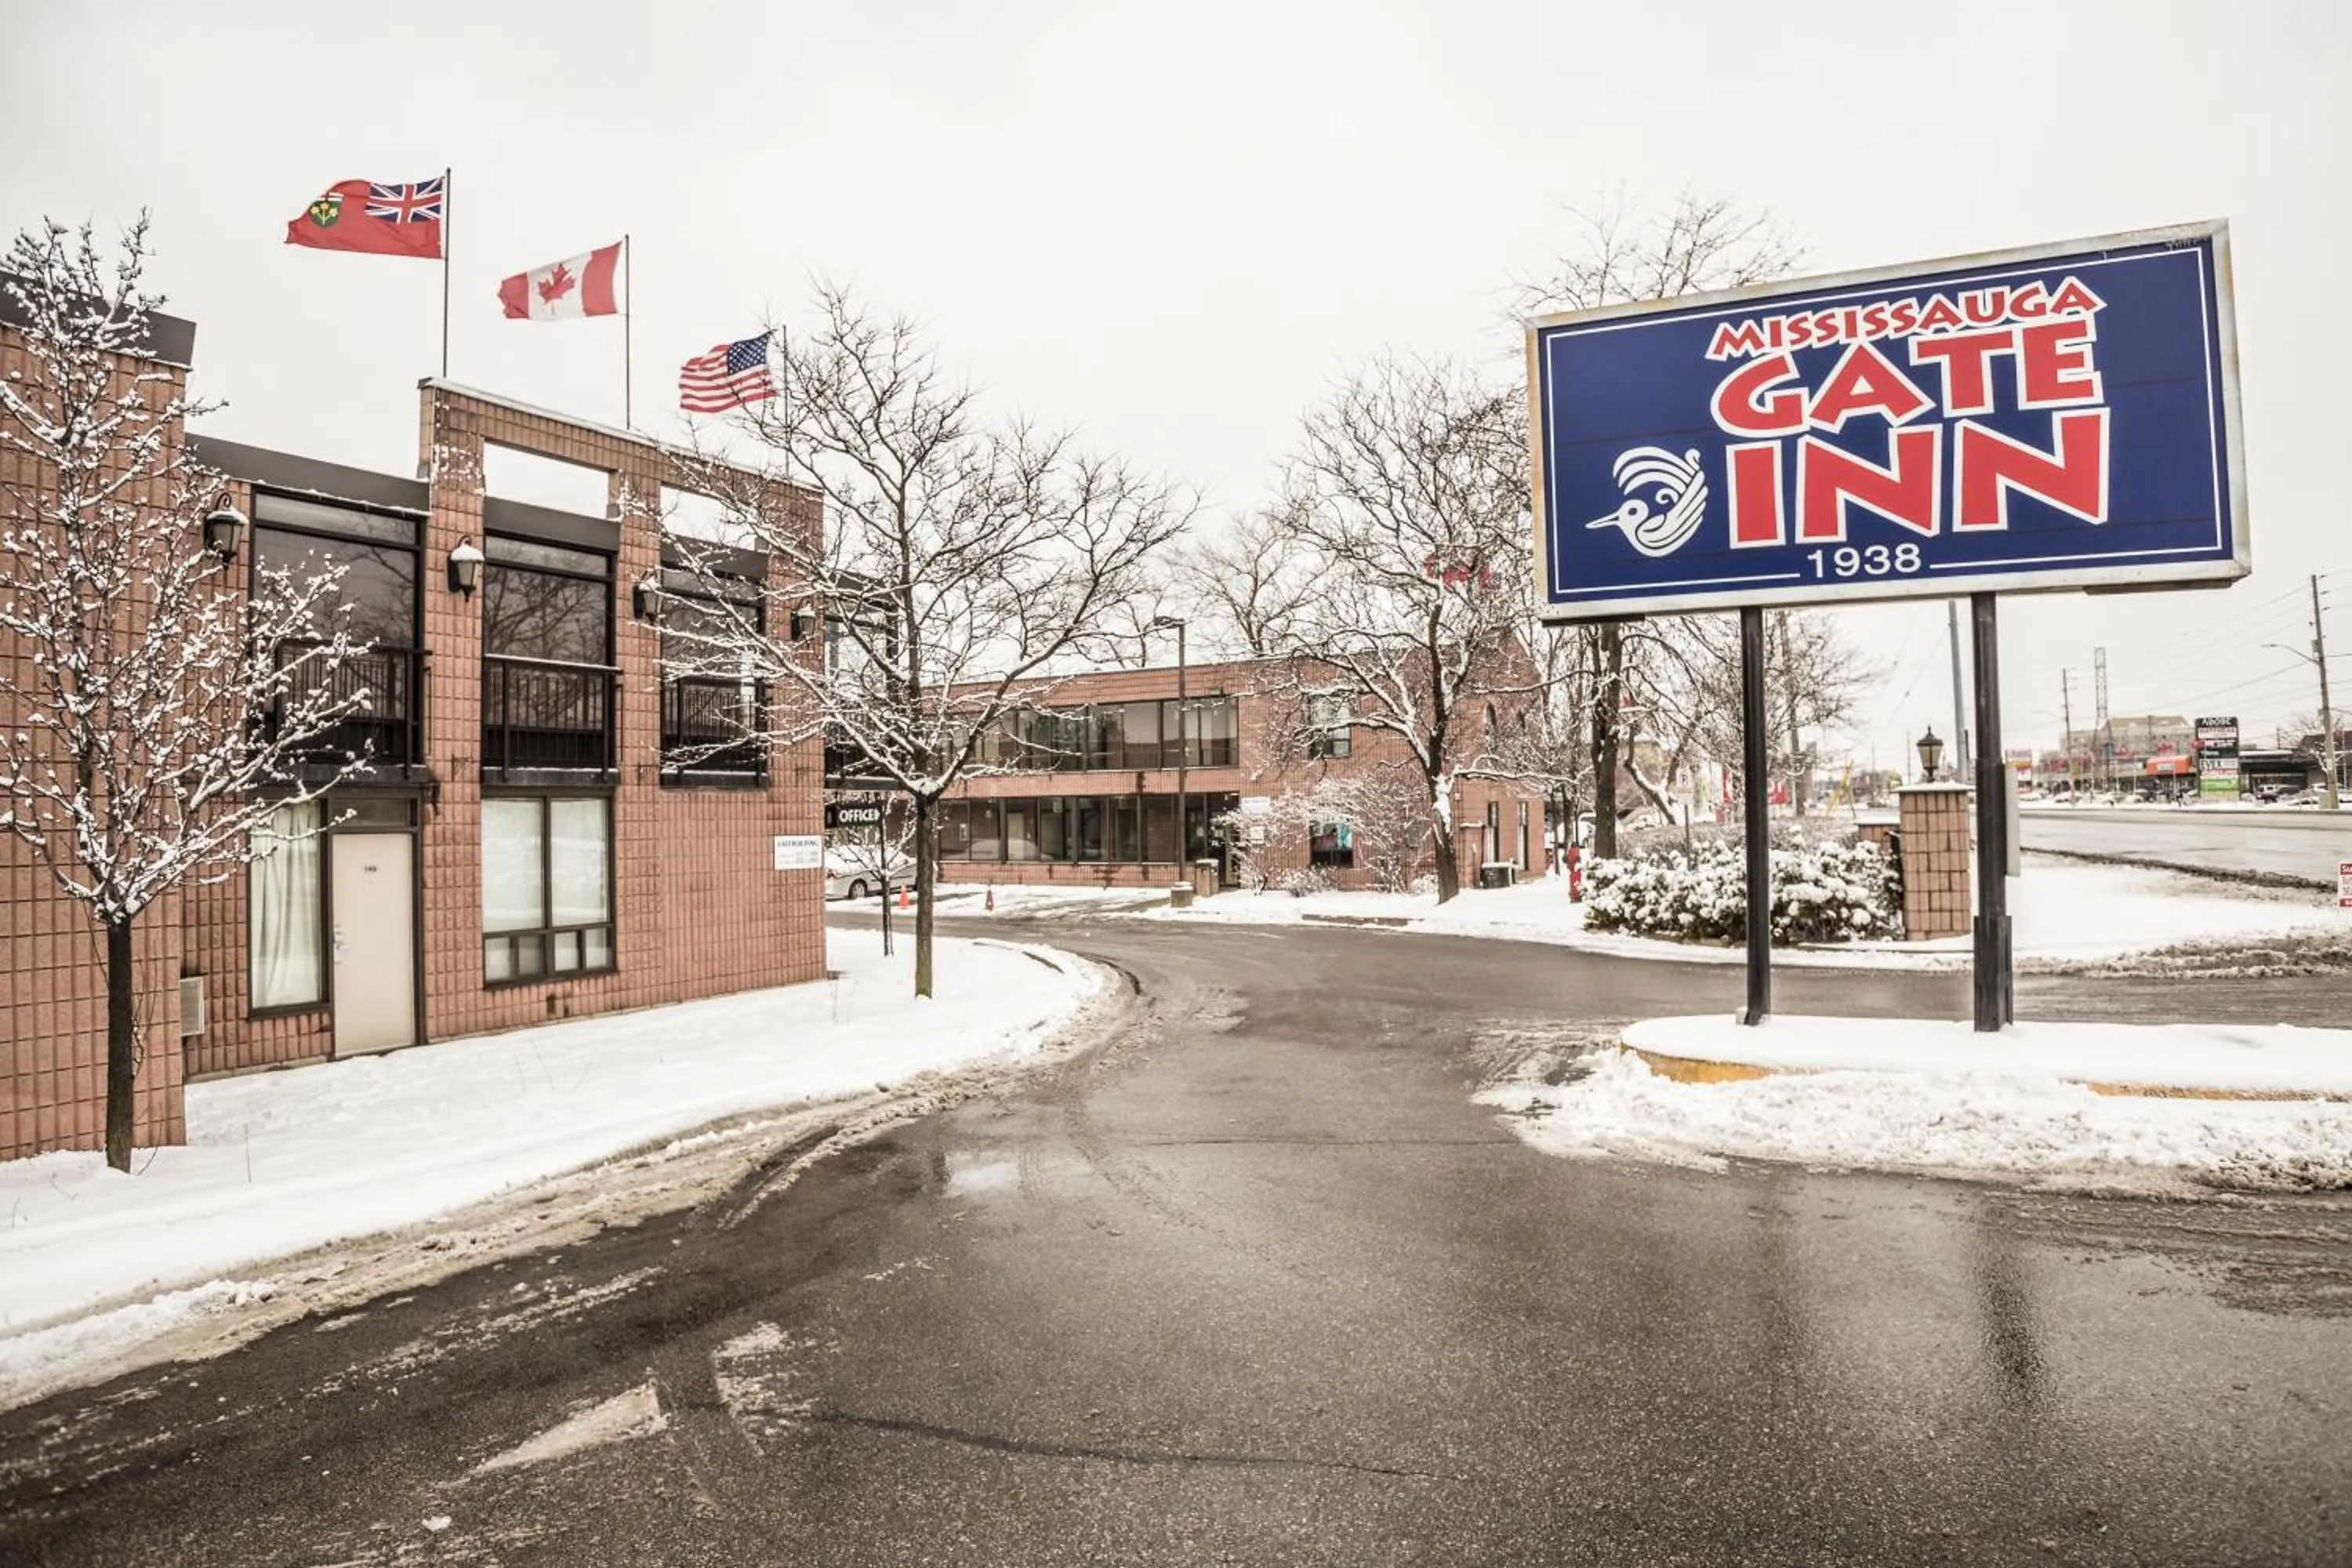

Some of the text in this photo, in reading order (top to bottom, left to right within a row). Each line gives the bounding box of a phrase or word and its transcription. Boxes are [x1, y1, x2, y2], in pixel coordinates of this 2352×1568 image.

[1706, 276, 2107, 360] MISSISSAUGA
[1711, 315, 2104, 437] GATE
[1726, 407, 2111, 549] INN
[1807, 543, 1921, 578] 1938
[839, 808, 874, 822] OFFICE
